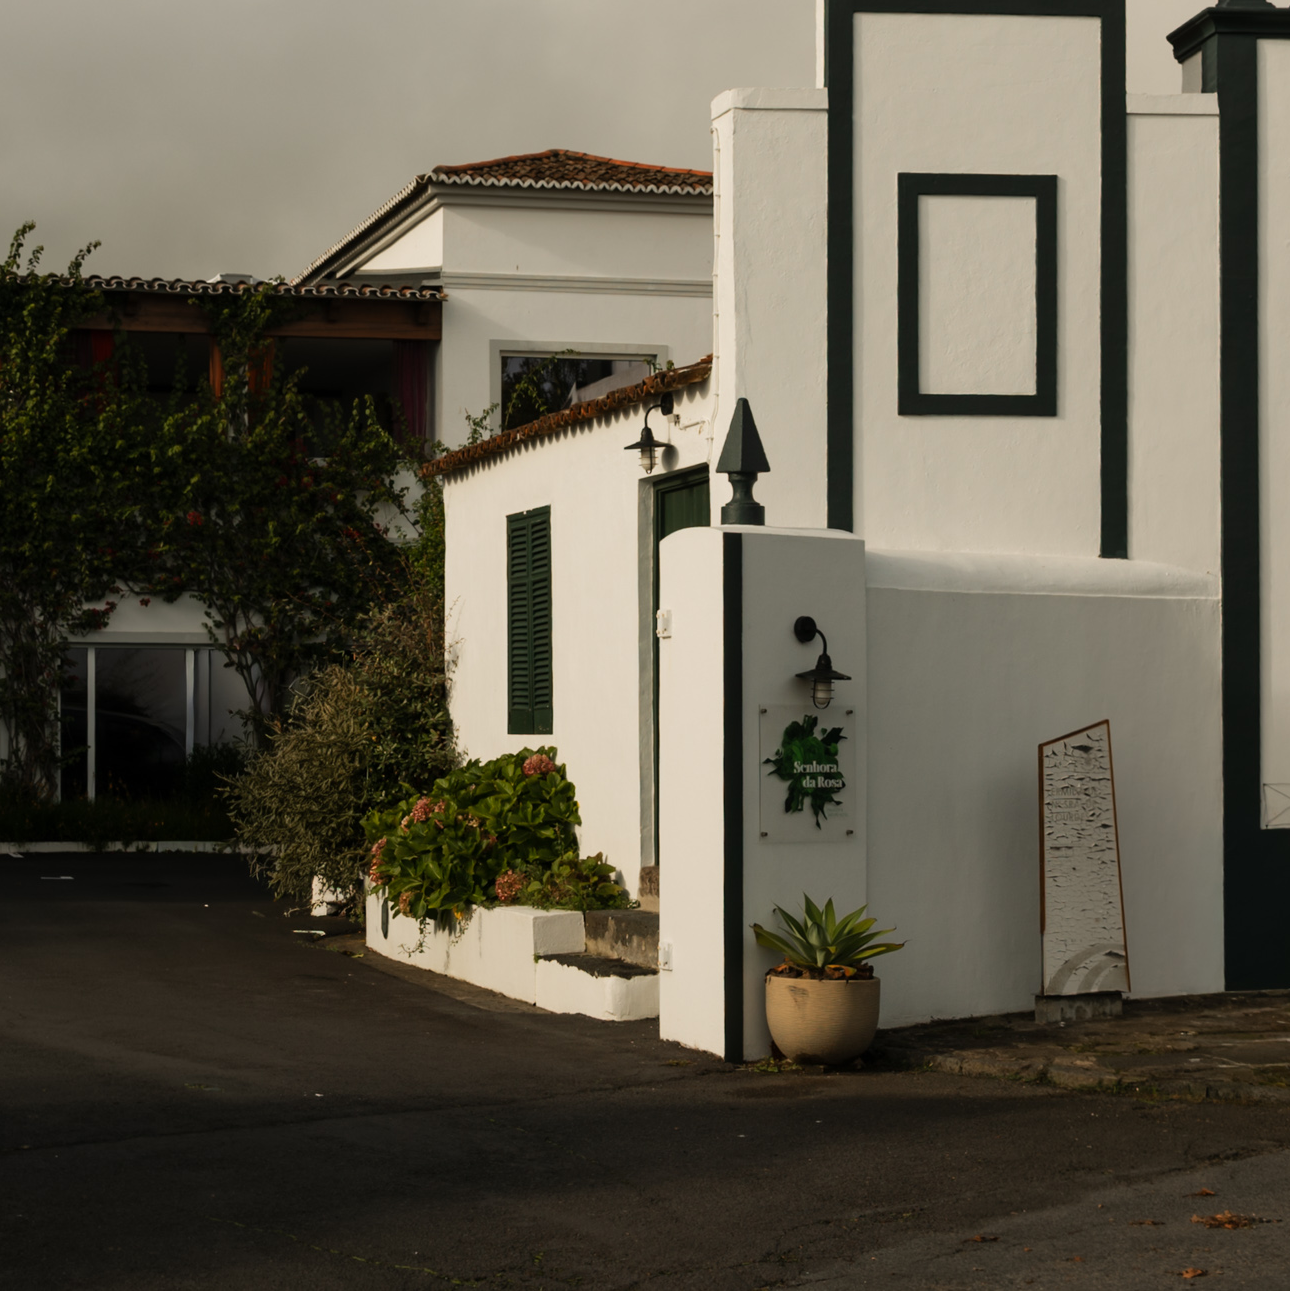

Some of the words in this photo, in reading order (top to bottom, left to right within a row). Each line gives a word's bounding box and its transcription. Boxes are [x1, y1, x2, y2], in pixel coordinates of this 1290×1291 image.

[793, 760, 837, 773] Senhora
[802, 775, 816, 788] da
[817, 776, 843, 788] Rosa
